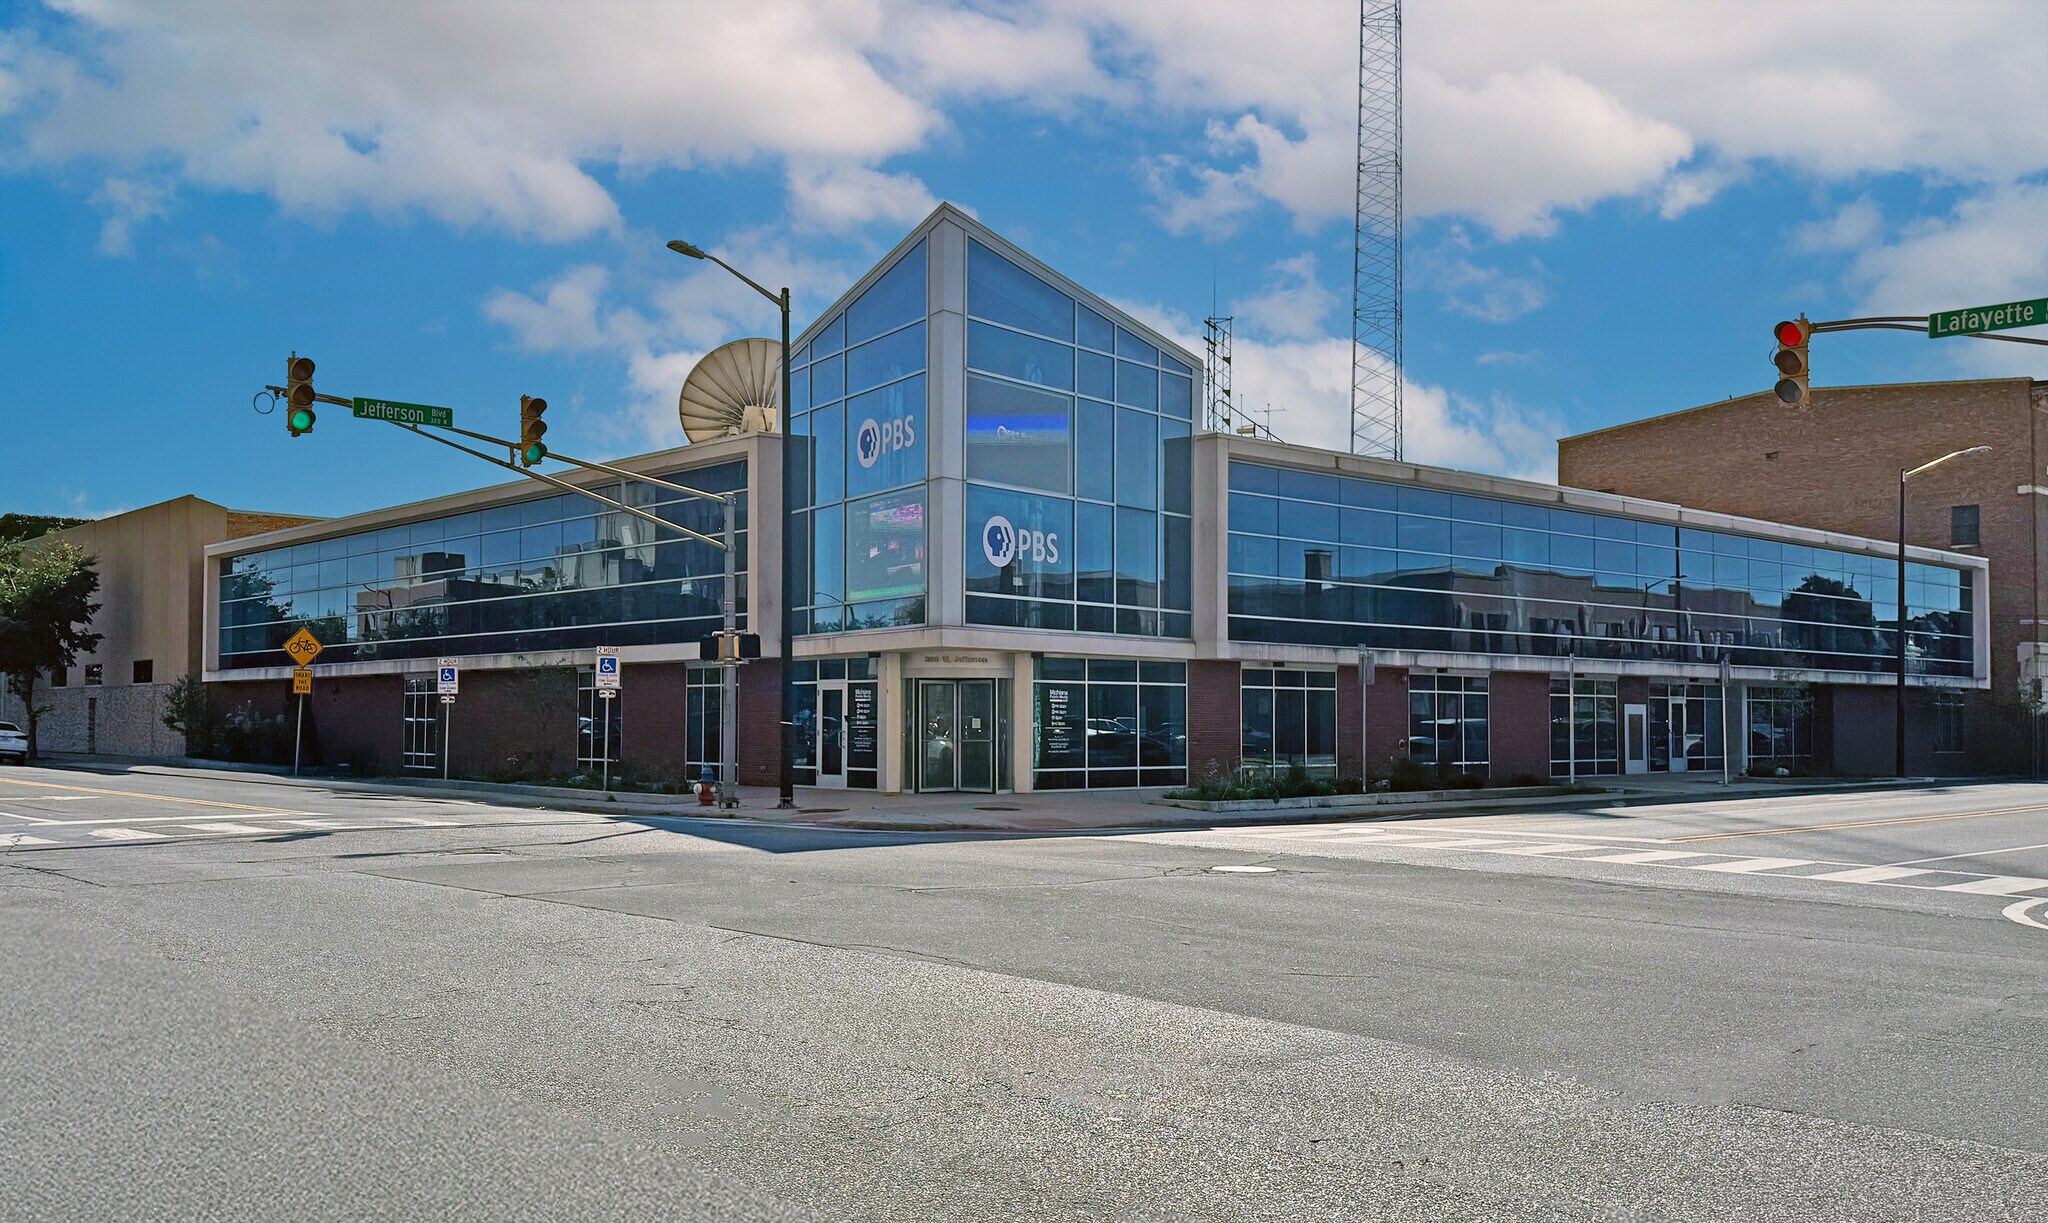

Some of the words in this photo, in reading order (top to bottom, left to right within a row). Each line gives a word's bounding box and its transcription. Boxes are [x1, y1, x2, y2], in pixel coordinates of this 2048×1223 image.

[1937, 304, 2034, 333] Lafayette
[360, 401, 424, 422] Jefferson
[431, 409, 447, 418] Blvd
[883, 415, 915, 454] PBS
[1018, 528, 1059, 564] PBS
